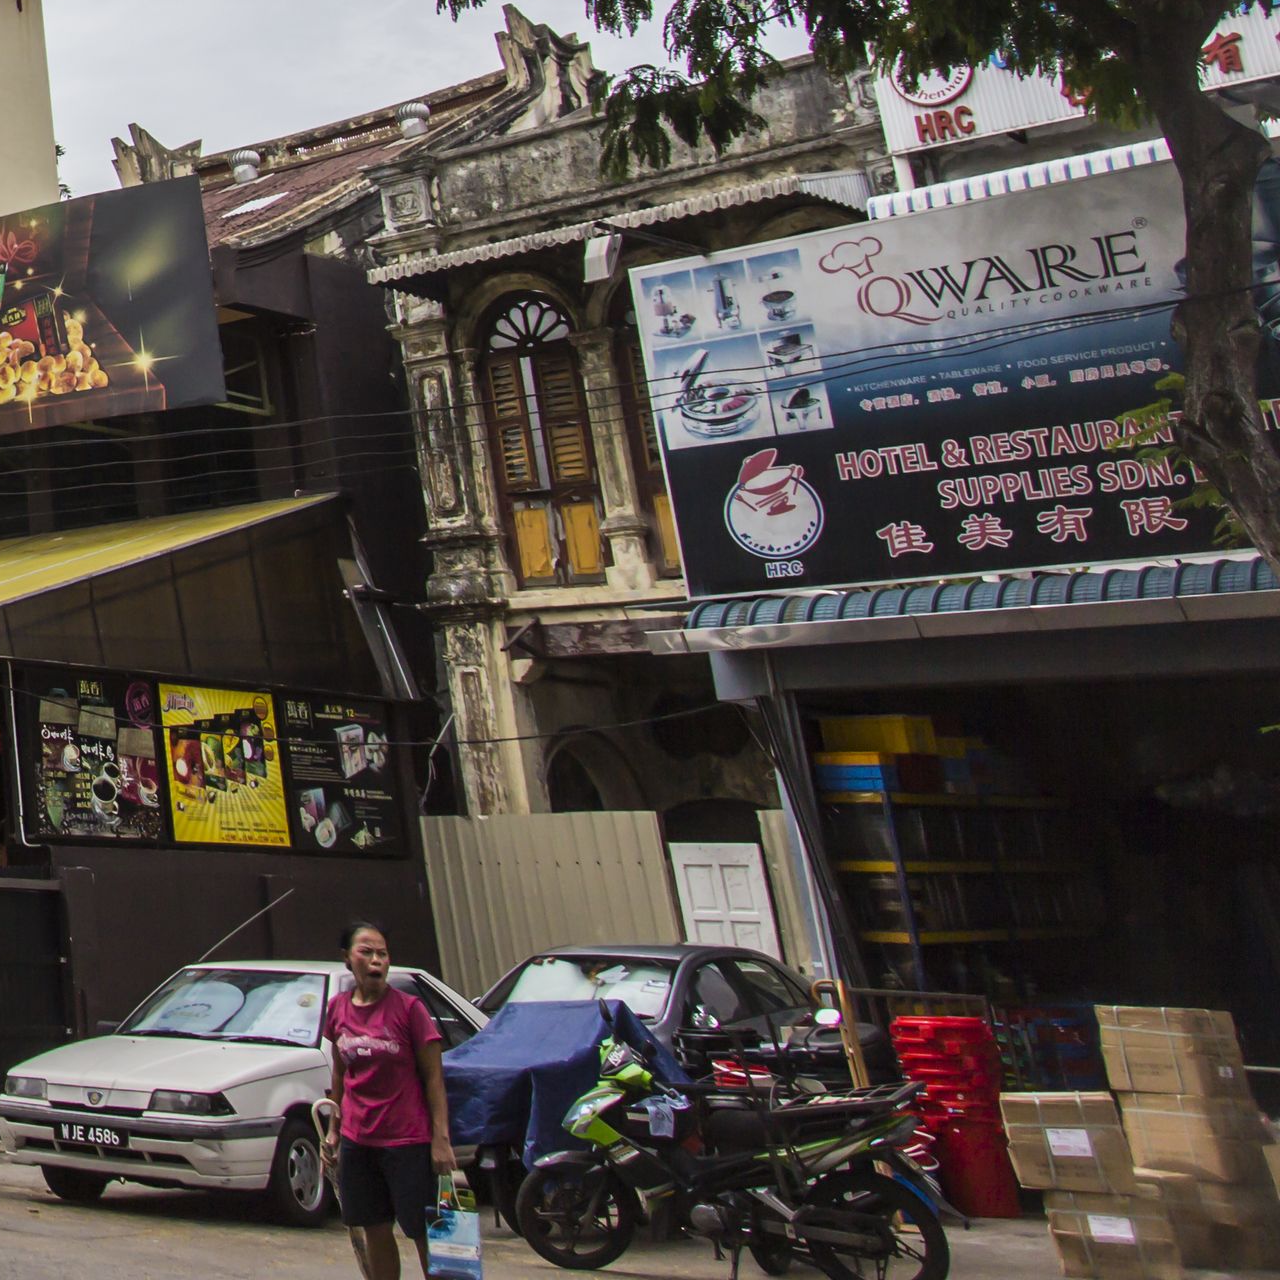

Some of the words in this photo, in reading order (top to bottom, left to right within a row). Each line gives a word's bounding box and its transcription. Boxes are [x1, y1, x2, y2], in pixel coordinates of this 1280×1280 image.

[913, 105, 976, 142] HRC
[856, 229, 1148, 327] QWARE
[946, 297, 1032, 320] QUALITY
[1039, 276, 1153, 305] COOKWARE
[853, 375, 927, 393] KITCHENWARE
[939, 363, 1003, 380] TABLEWARE
[1016, 357, 1048, 370] FOOD
[1049, 349, 1099, 365] SERVICE
[1100, 341, 1157, 357] PRODUCT
[835, 443, 938, 481] HOTEL
[940, 438, 967, 469] &
[937, 463, 1094, 509] SUPPLIES
[1096, 456, 1186, 493] SDN.
[765, 560, 804, 579] HRC
